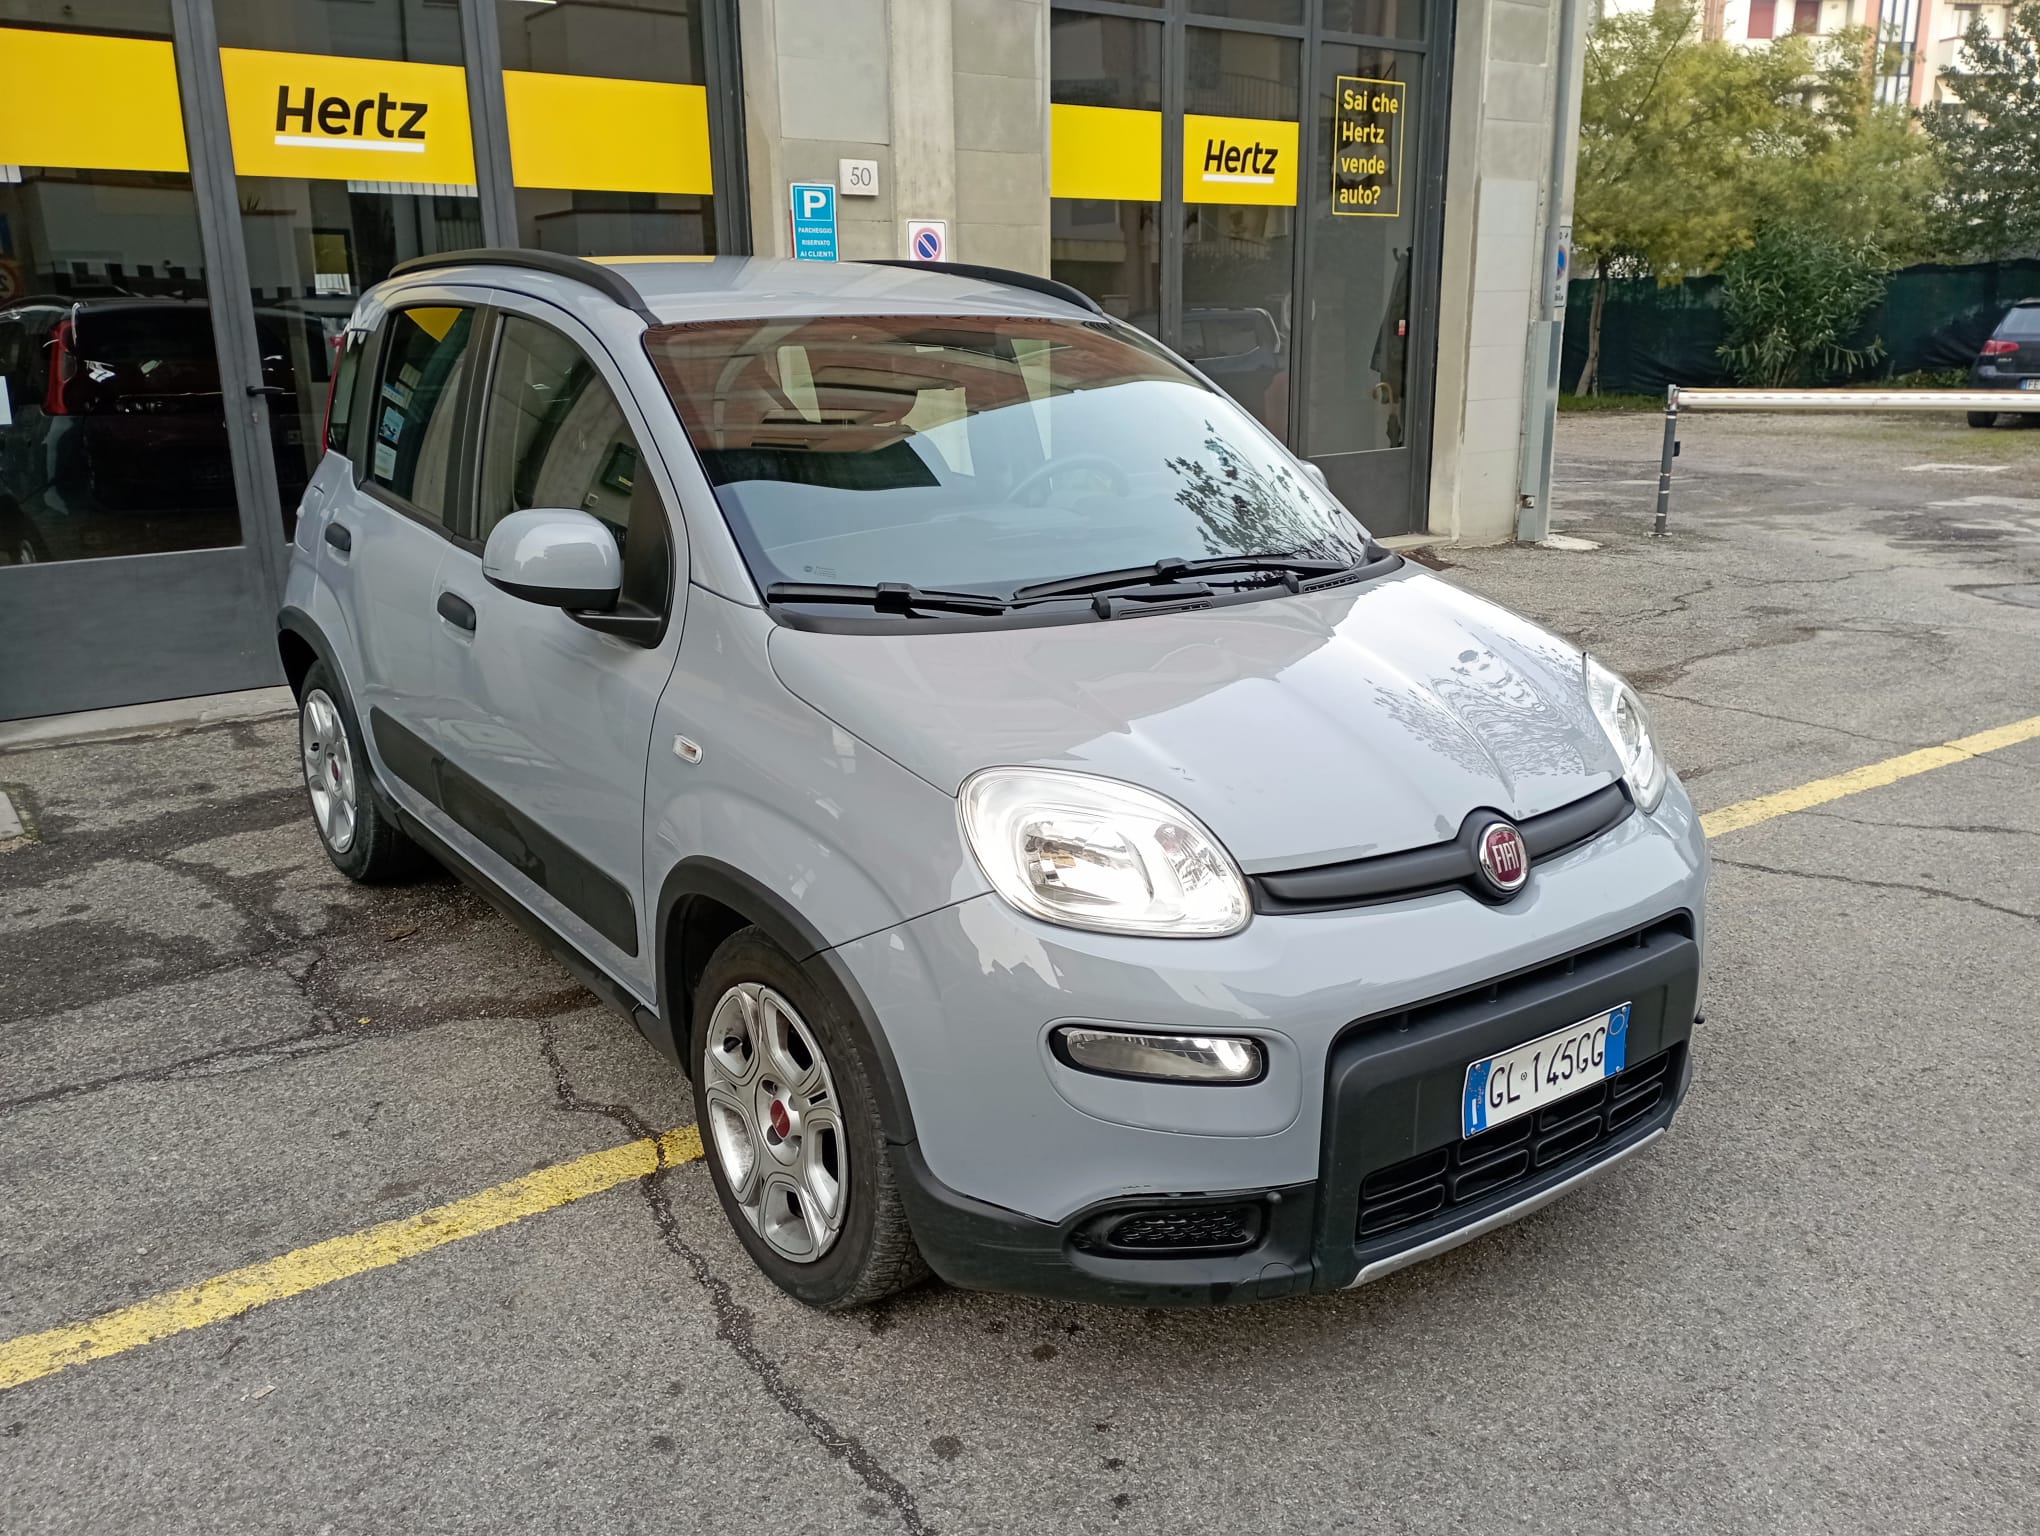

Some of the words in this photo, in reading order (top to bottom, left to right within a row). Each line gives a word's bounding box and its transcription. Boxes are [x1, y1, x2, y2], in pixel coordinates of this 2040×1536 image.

[276, 85, 428, 139] Hertz
[1343, 89, 1368, 111] Sai
[1371, 92, 1399, 114] che
[1342, 121, 1385, 144] Hertz
[1204, 139, 1278, 174] Hertz
[1341, 154, 1385, 174] vende
[850, 166, 872, 186] 50
[803, 190, 827, 218] P
[1340, 185, 1381, 205] auto?
[1491, 840, 1520, 874] FIAT
